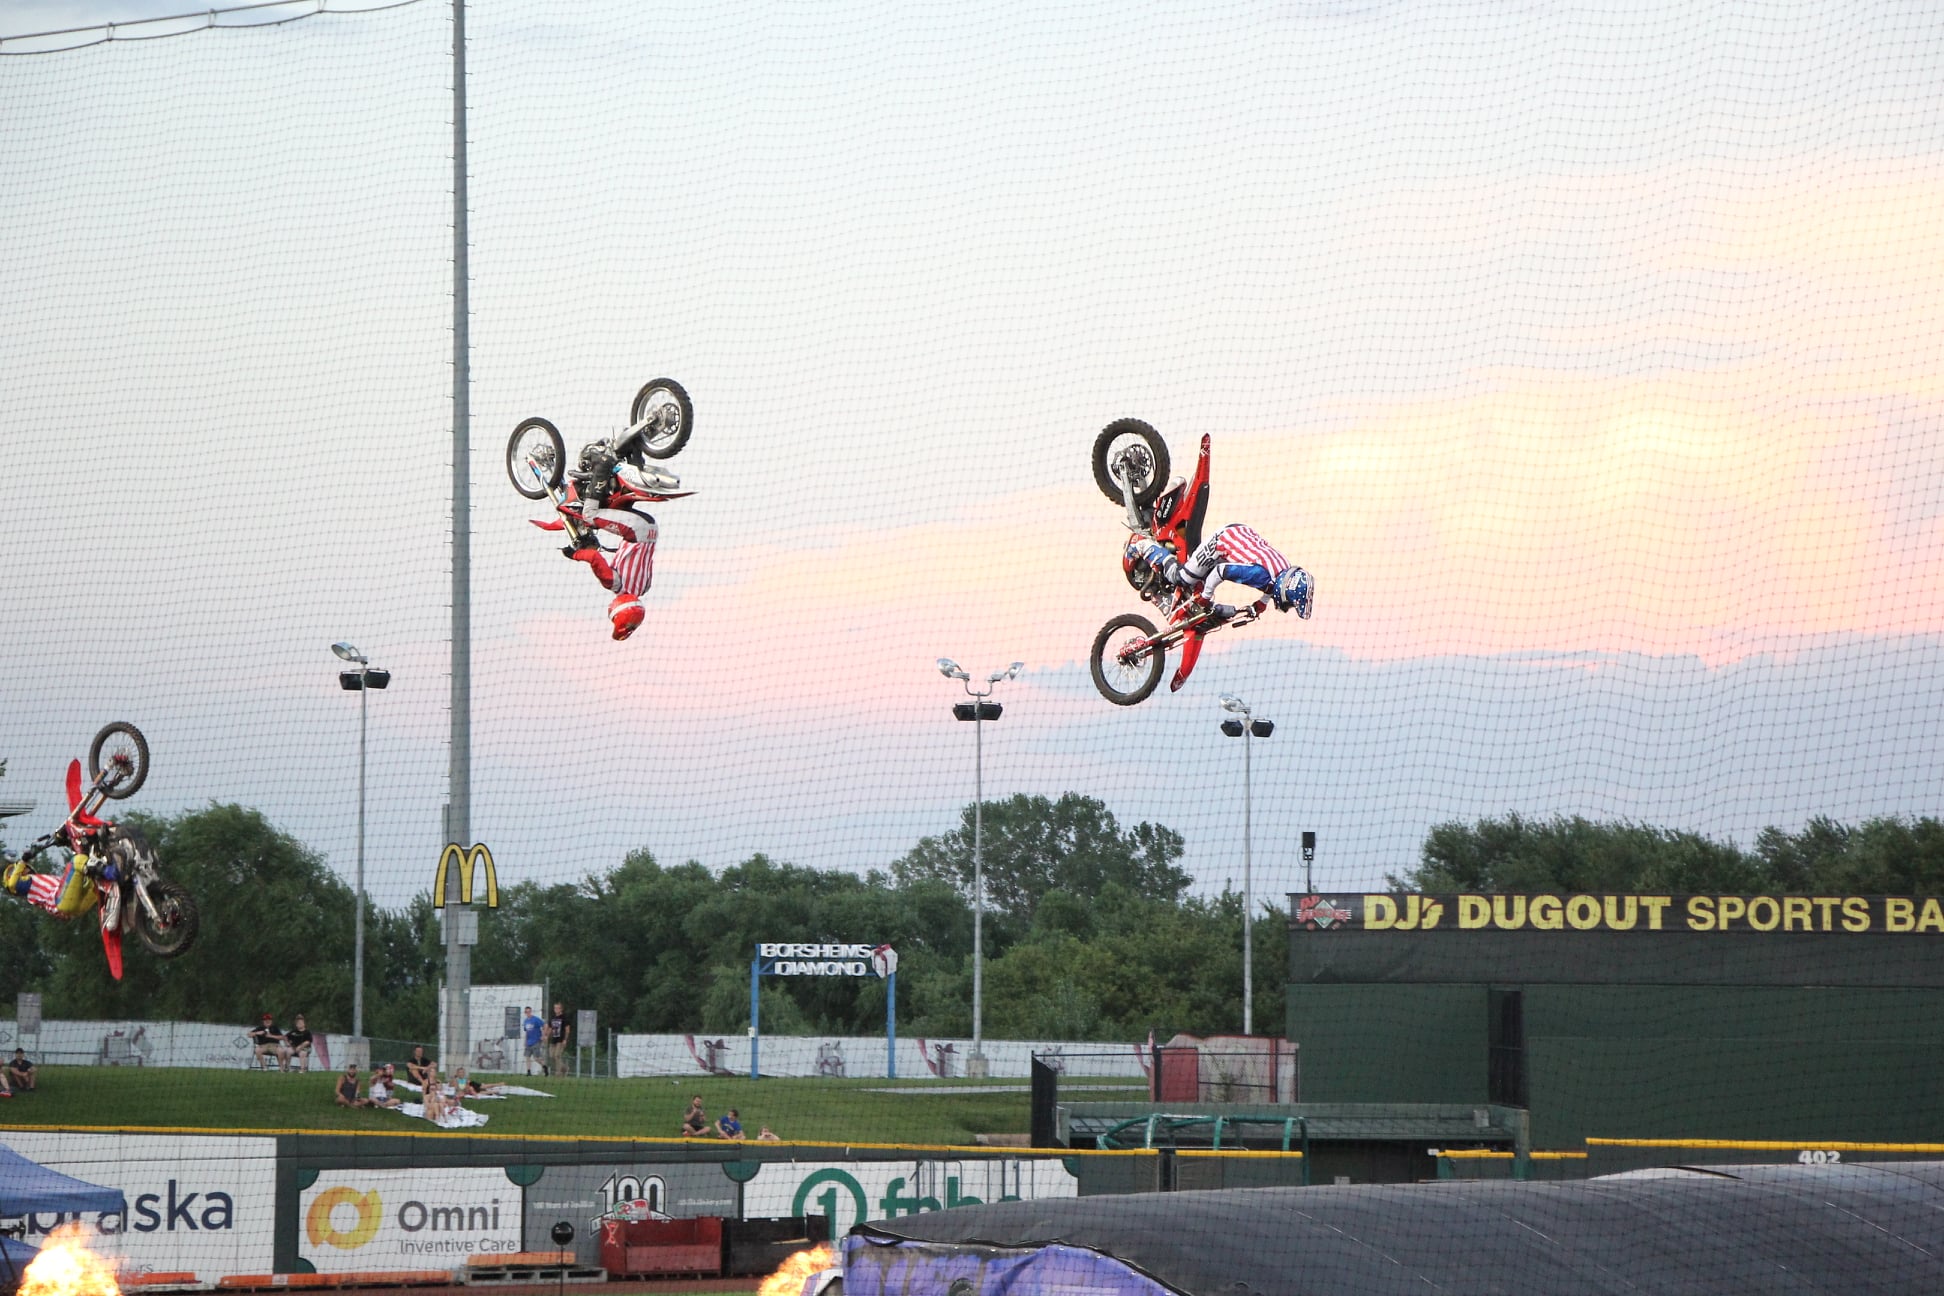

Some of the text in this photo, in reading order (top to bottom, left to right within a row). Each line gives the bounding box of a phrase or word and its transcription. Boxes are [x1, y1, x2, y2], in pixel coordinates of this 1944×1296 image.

[1458, 894, 1672, 931] DUGOUT
[1686, 896, 1872, 933] SPORTS
[774, 961, 867, 976] DIAMOND
[1797, 1150, 1841, 1164] 402
[398, 1198, 499, 1232] Omni
[400, 1238, 516, 1254] Inventive Care
